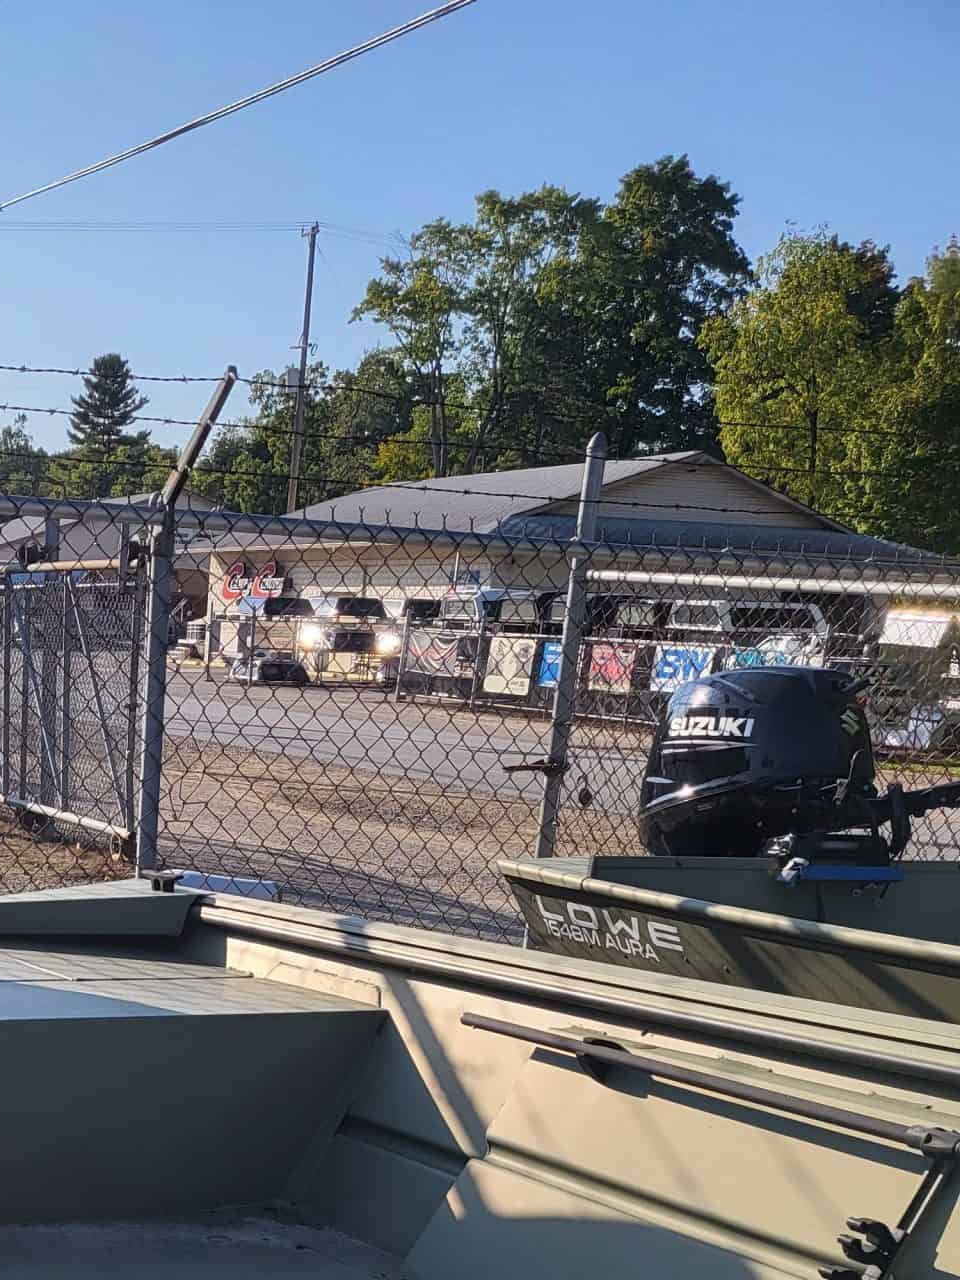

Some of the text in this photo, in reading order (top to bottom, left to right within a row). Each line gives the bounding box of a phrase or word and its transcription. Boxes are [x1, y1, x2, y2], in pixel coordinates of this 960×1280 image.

[668, 716, 755, 737] SUZUKI
[535, 895, 684, 952] LOWE
[544, 918, 660, 963] 1648M AURA
